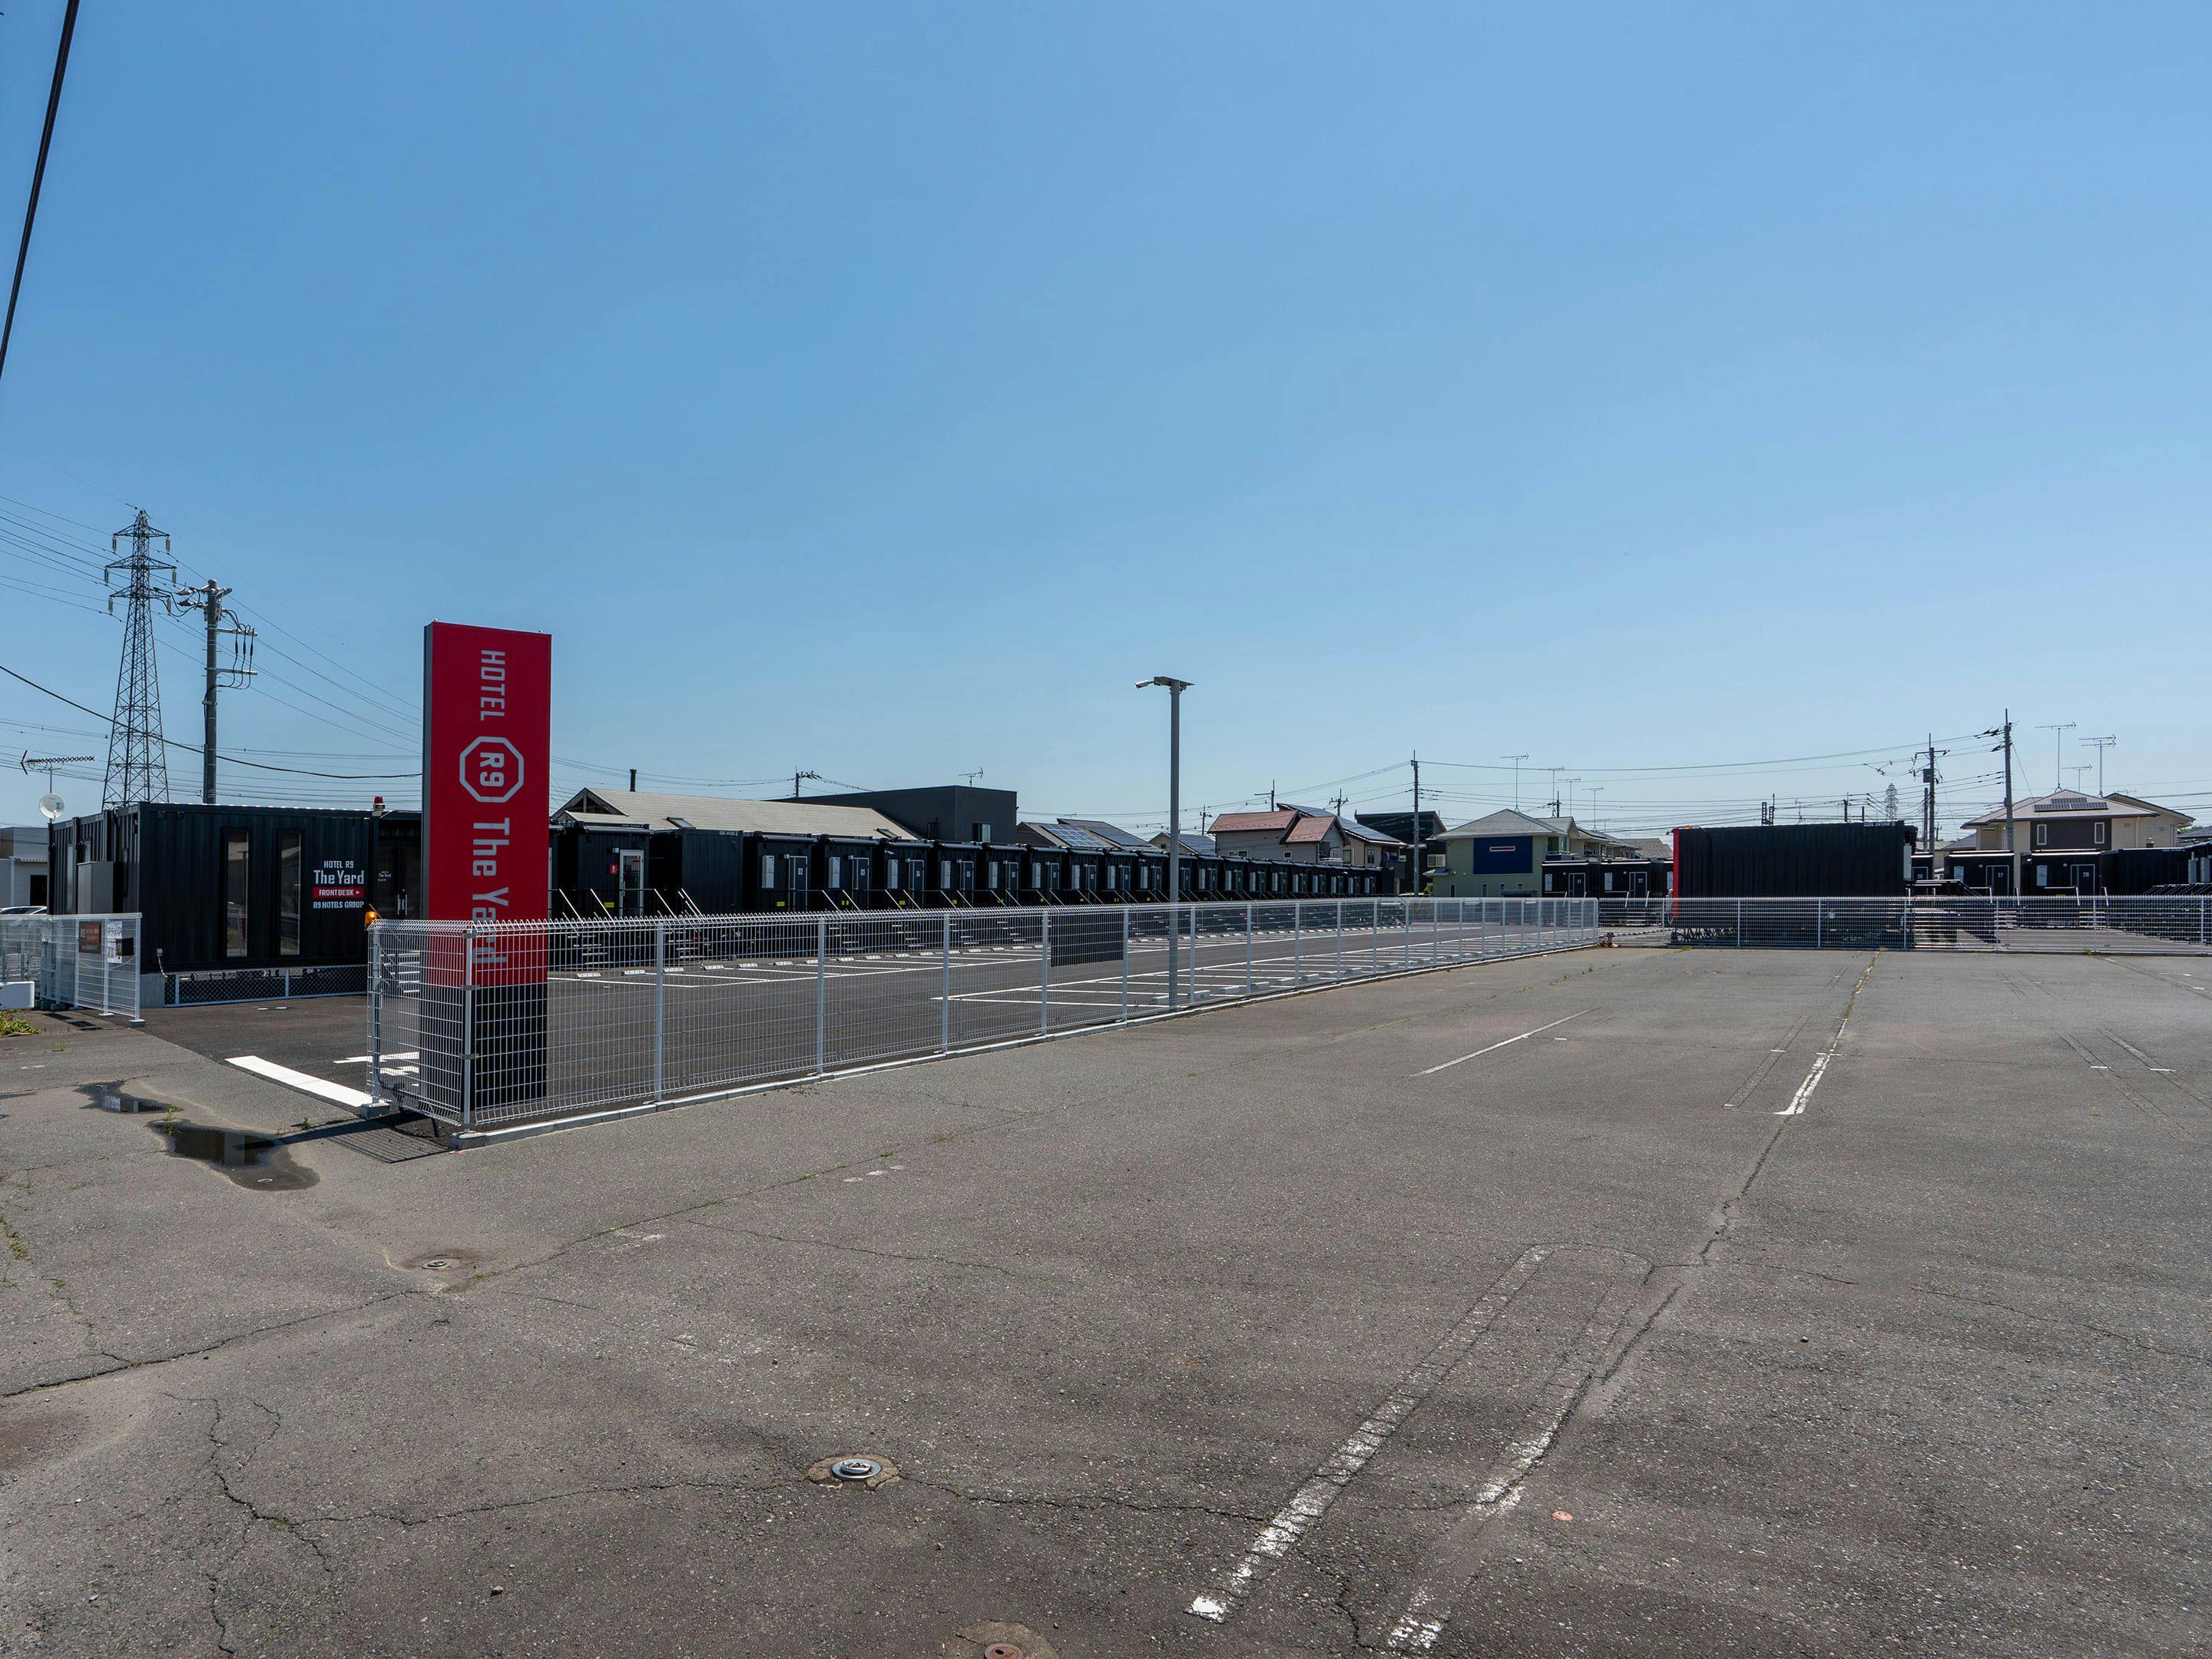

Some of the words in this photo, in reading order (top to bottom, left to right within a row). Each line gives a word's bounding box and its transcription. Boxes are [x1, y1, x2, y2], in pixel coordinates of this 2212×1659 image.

[481, 650, 505, 721] HOTEL
[479, 752, 505, 787] R9
[472, 817, 510, 876] The
[313, 869, 336, 885] The
[336, 869, 365, 885] Yard
[323, 860, 343, 869] HOTEL
[345, 860, 354, 869] R9
[797, 867, 803, 876] 02
